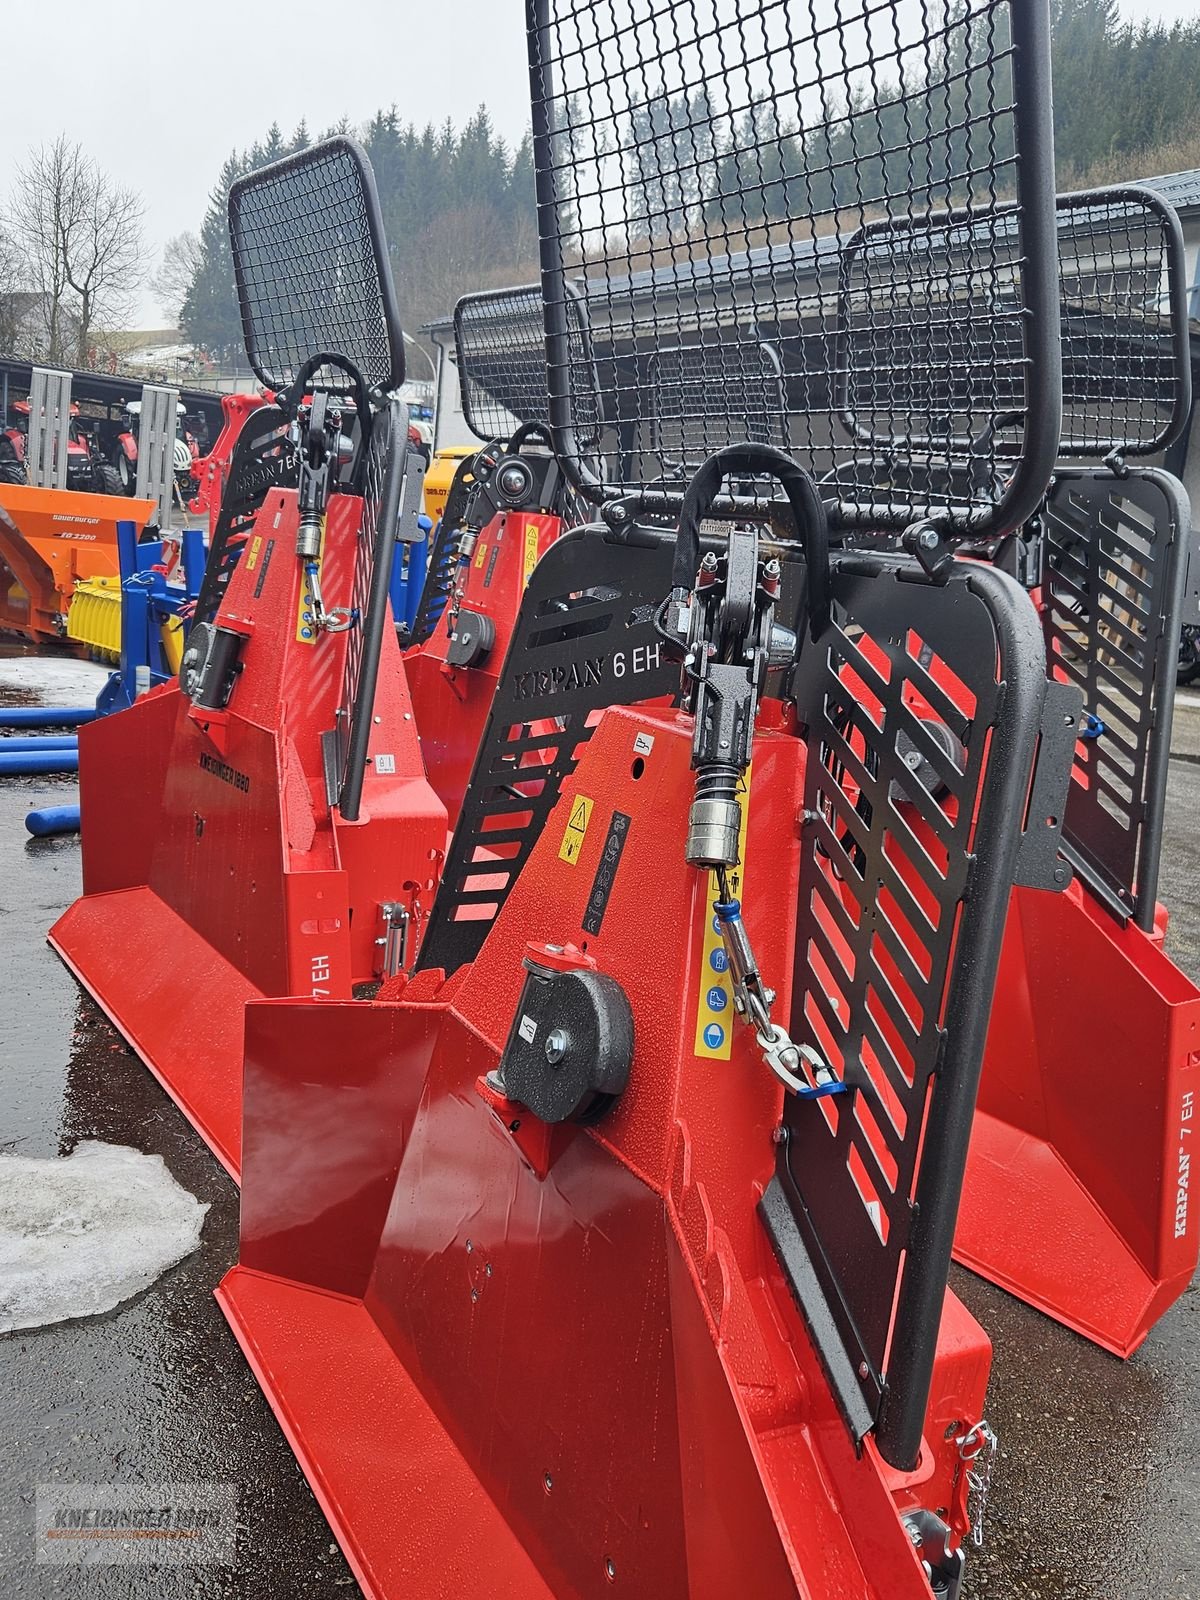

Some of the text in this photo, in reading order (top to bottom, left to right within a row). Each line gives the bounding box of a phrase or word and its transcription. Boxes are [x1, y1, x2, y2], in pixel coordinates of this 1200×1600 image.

[278, 459, 284, 474] 7
[513, 643, 660, 702] KRPAN 6 EH
[312, 955, 330, 998] 7 EH
[1181, 1091, 1194, 1121] EH
[1180, 1127, 1192, 1140] 7
